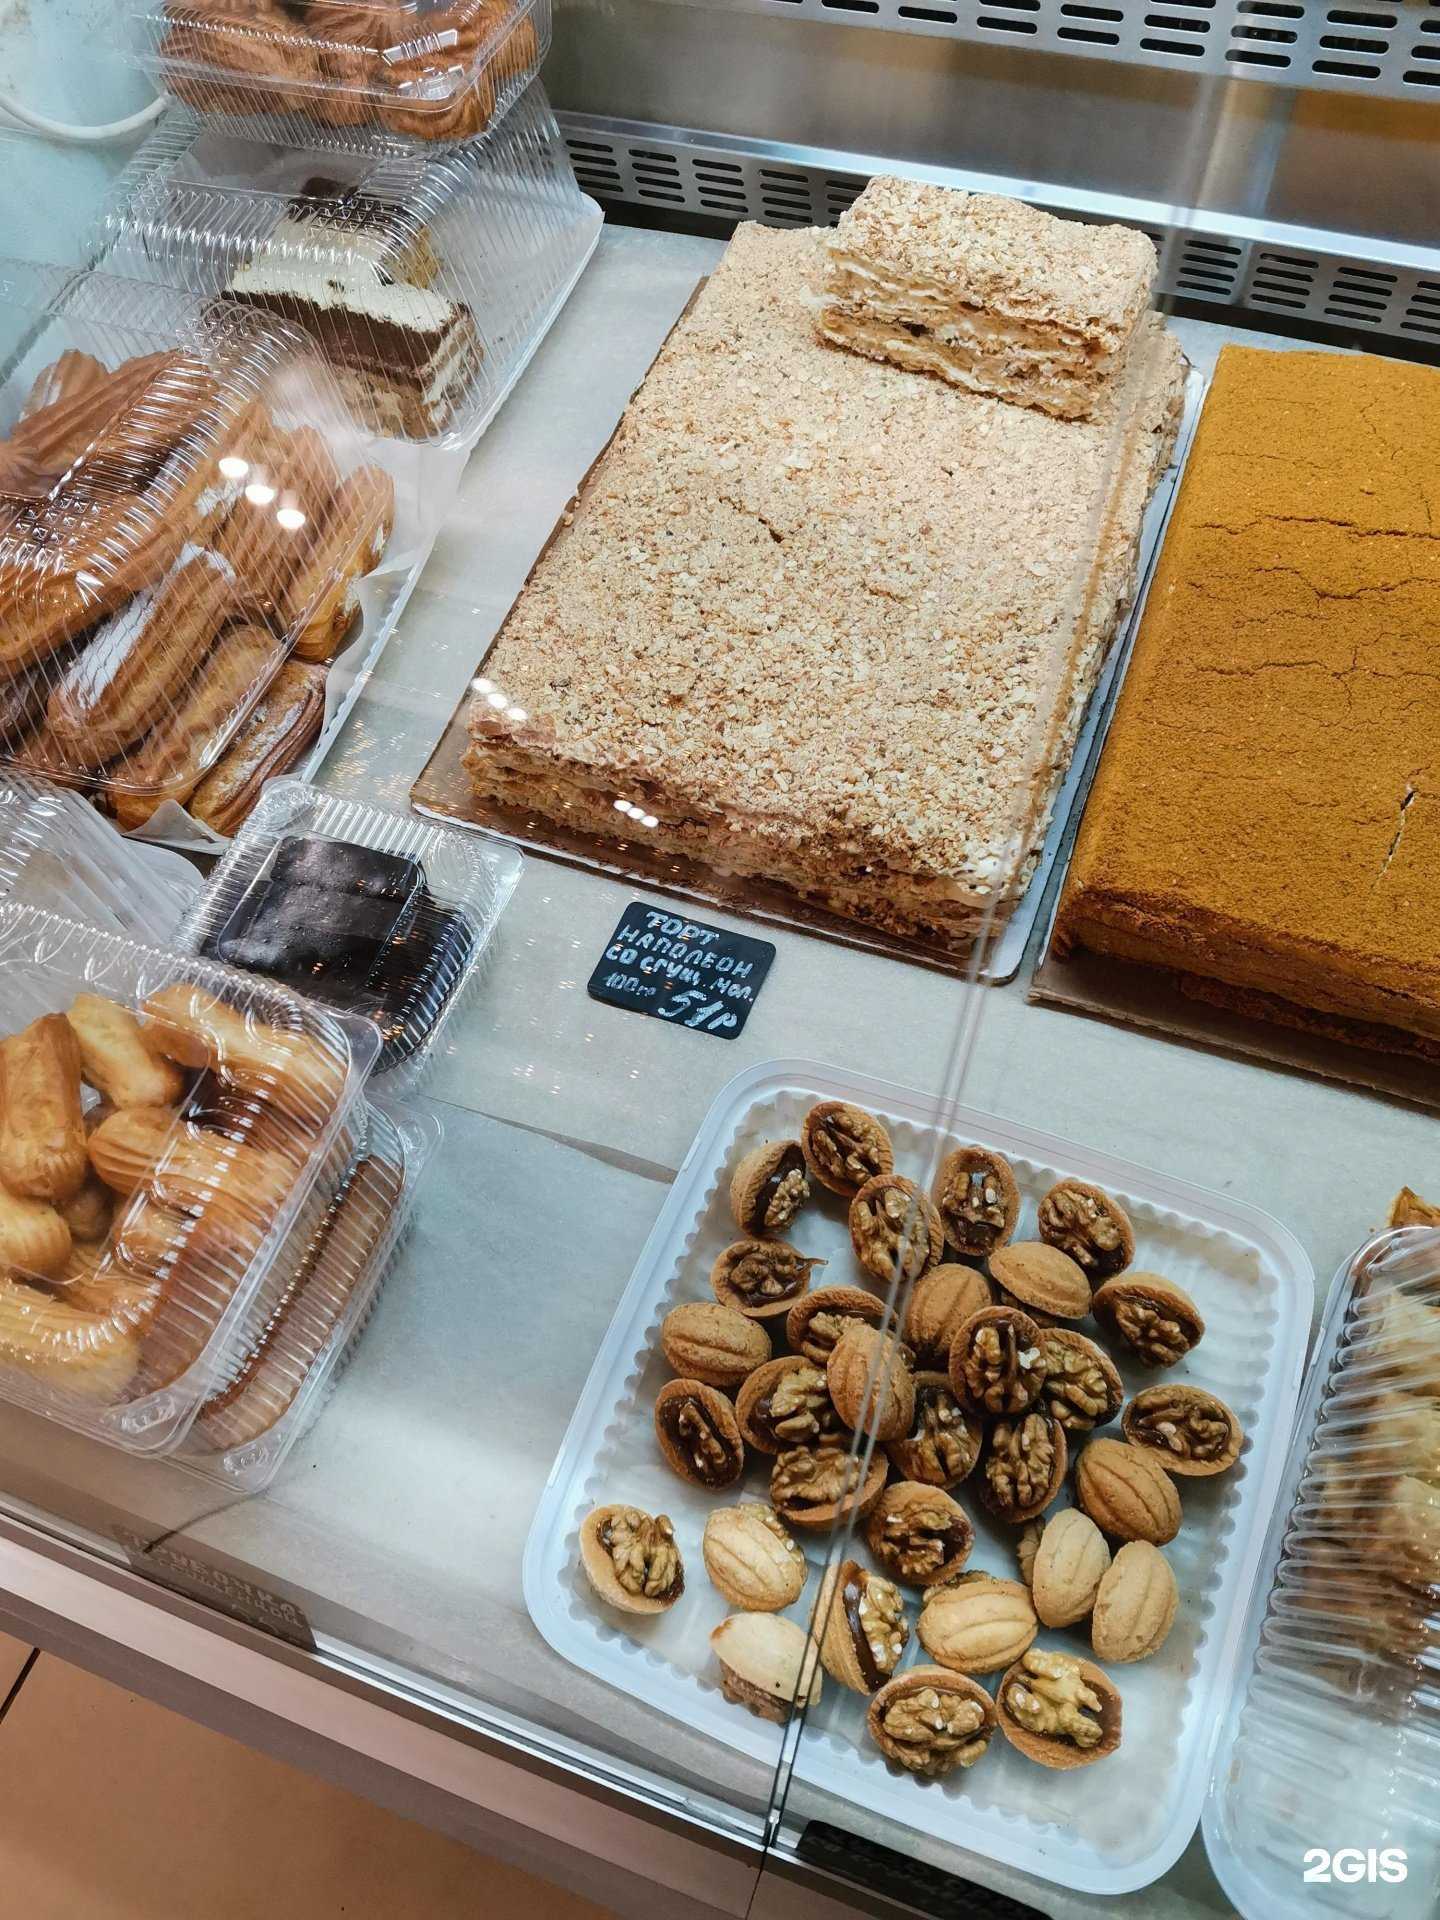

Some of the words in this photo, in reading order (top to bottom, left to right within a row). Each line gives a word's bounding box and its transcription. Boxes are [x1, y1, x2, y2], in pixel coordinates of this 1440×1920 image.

[646, 911, 720, 945] ТОРТ
[606, 944, 638, 965] СО
[616, 924, 753, 978] НАПОЛЕОН
